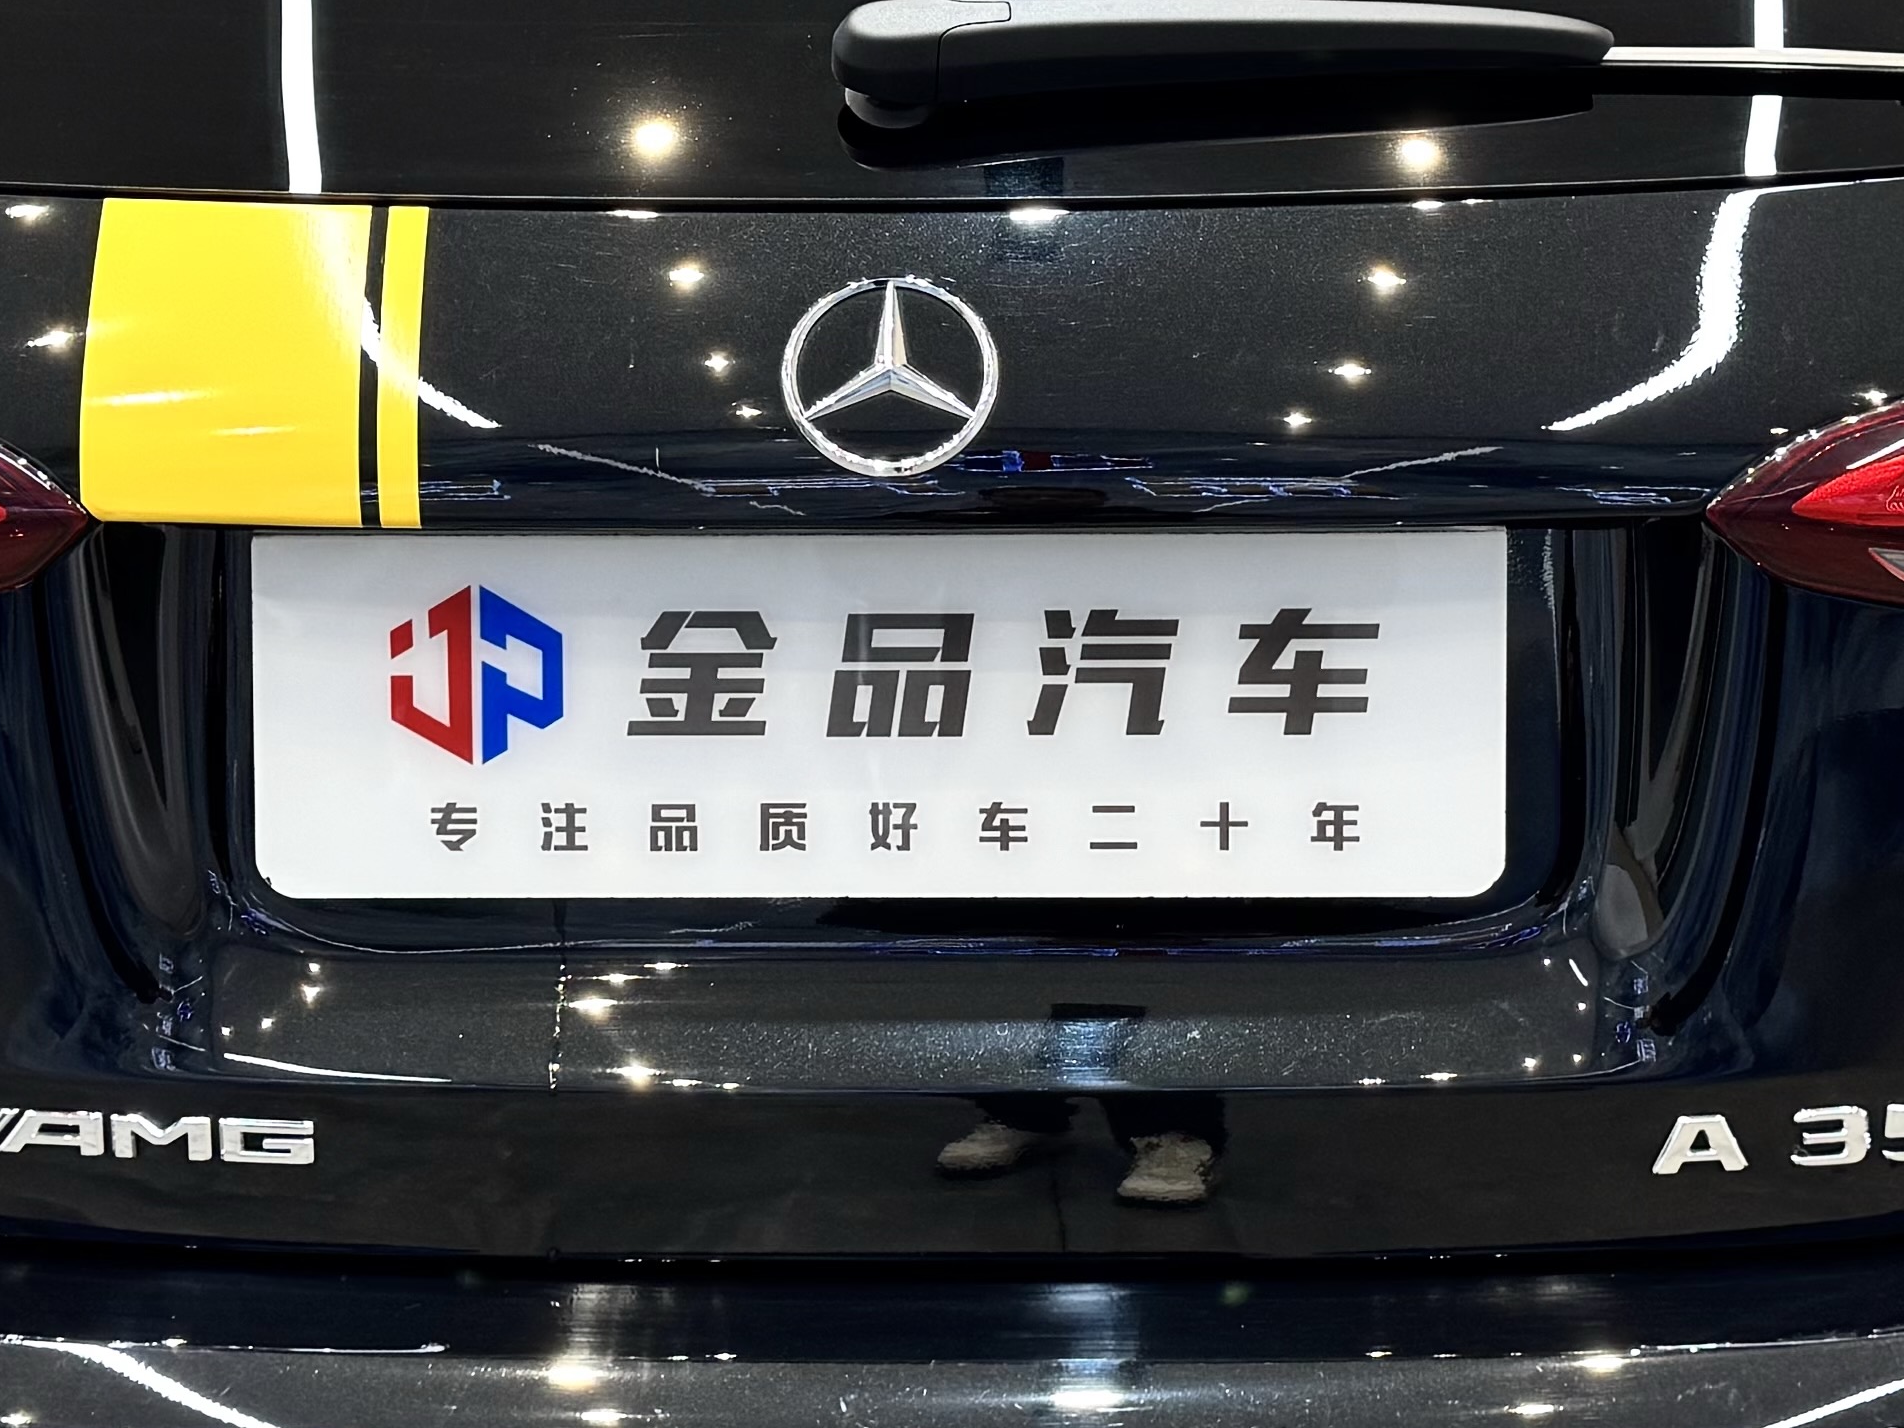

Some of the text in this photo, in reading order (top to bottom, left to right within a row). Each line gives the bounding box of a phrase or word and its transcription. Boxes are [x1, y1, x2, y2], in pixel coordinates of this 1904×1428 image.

[626, 608, 1382, 738] 金品汽车
[430, 801, 1362, 853] 专注品质好车二十年
[1651, 1113, 1750, 1176] A
